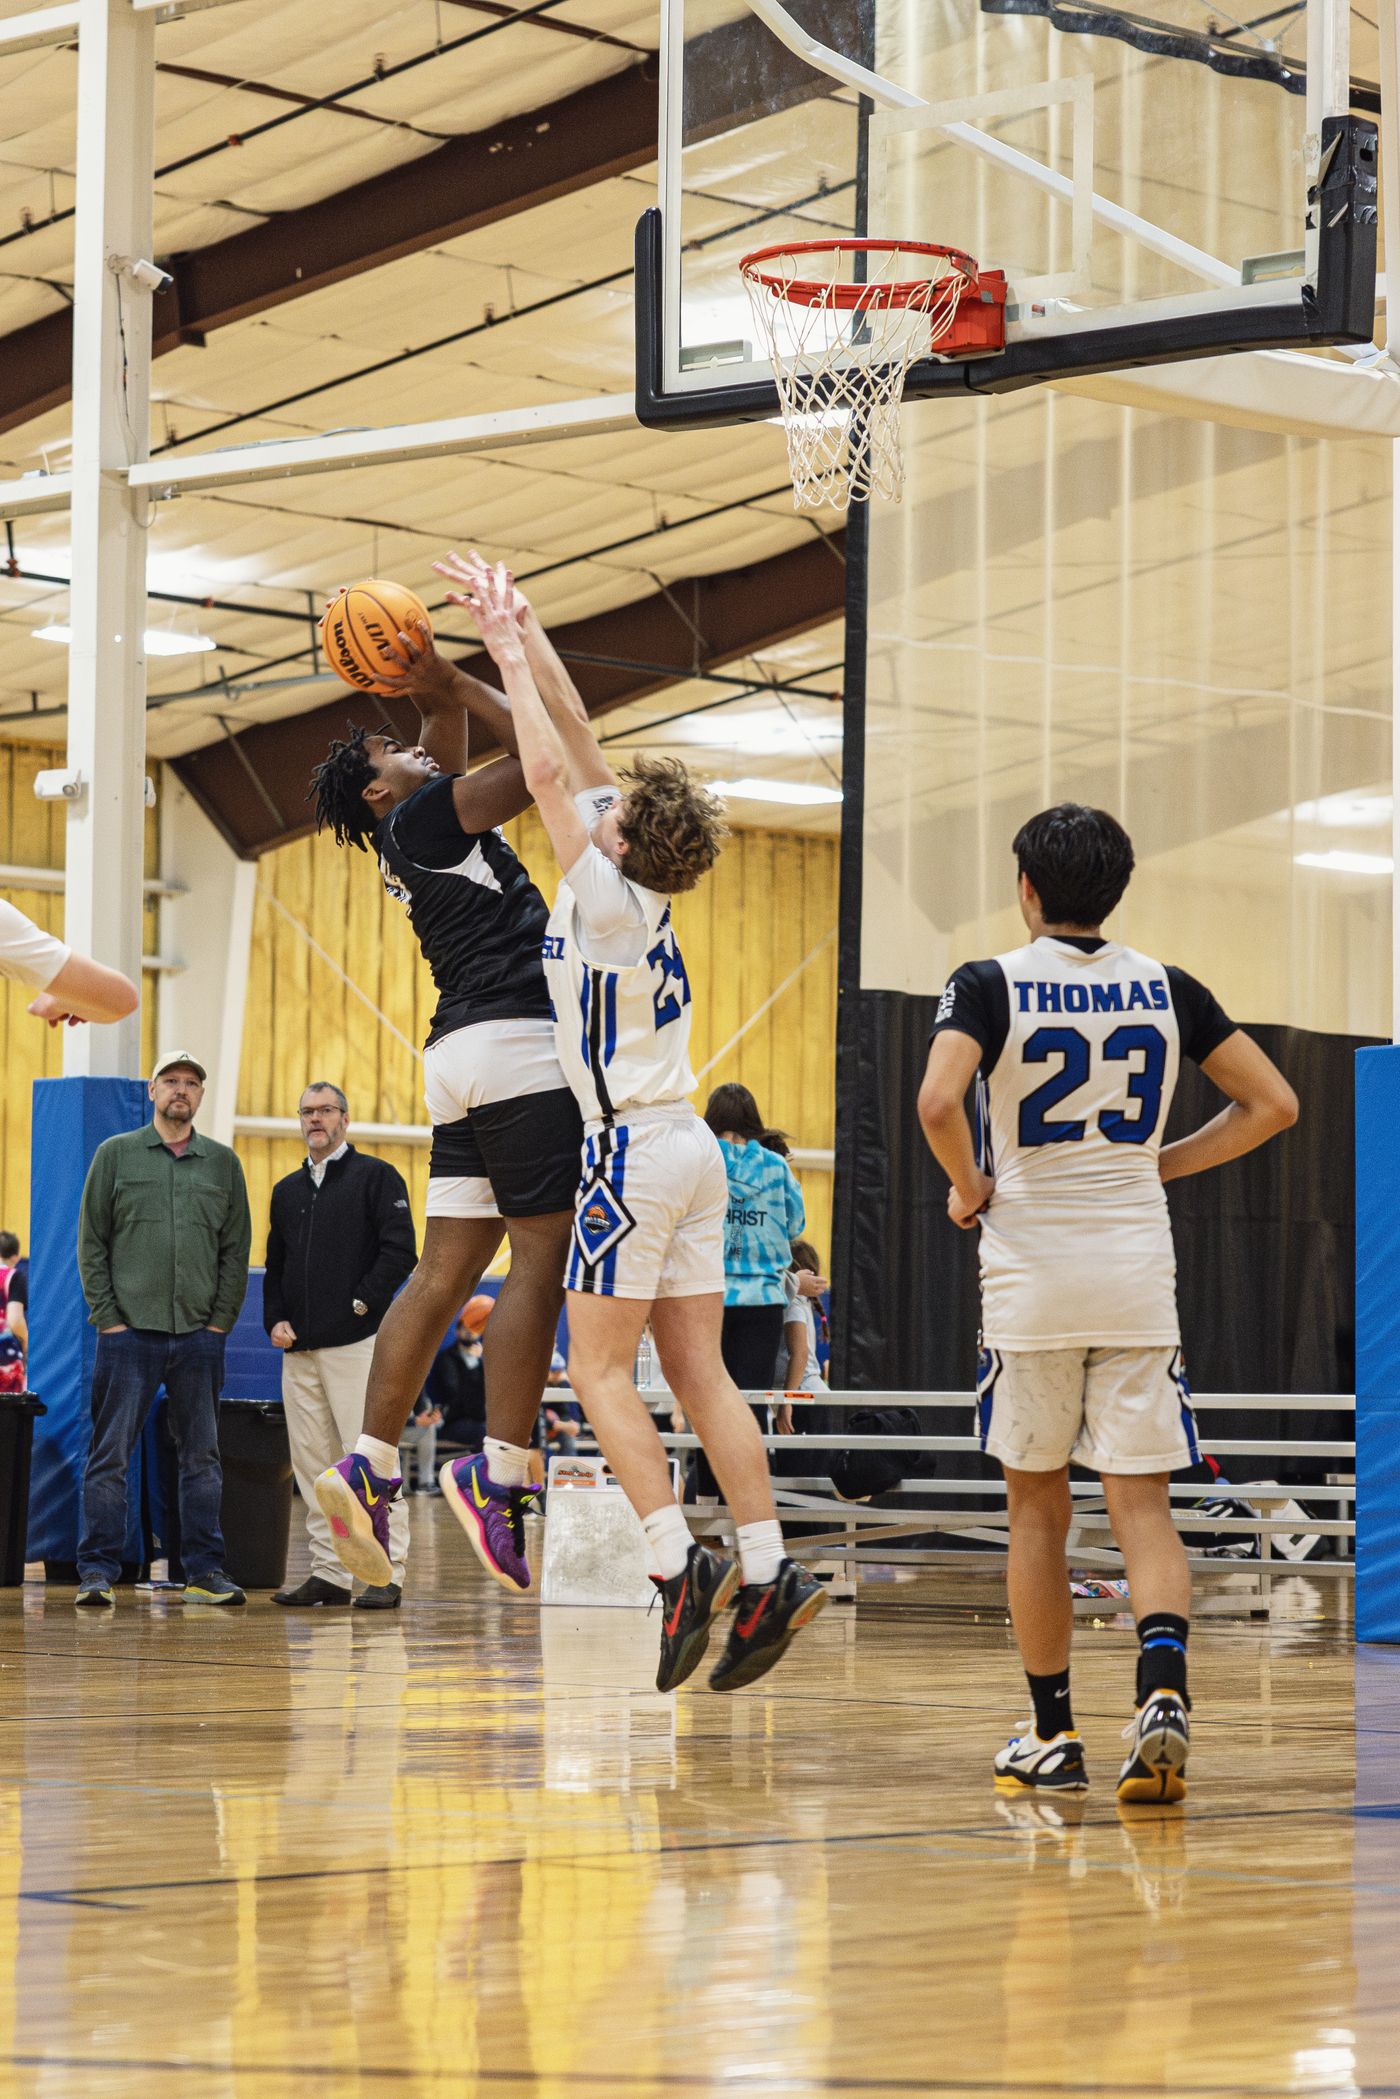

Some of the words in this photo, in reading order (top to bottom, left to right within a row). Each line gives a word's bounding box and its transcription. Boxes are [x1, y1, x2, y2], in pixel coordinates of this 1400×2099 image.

[334, 620, 375, 687] Wilson
[1013, 980, 1169, 1013] THOMAS
[1018, 1024, 1167, 1147] 23
